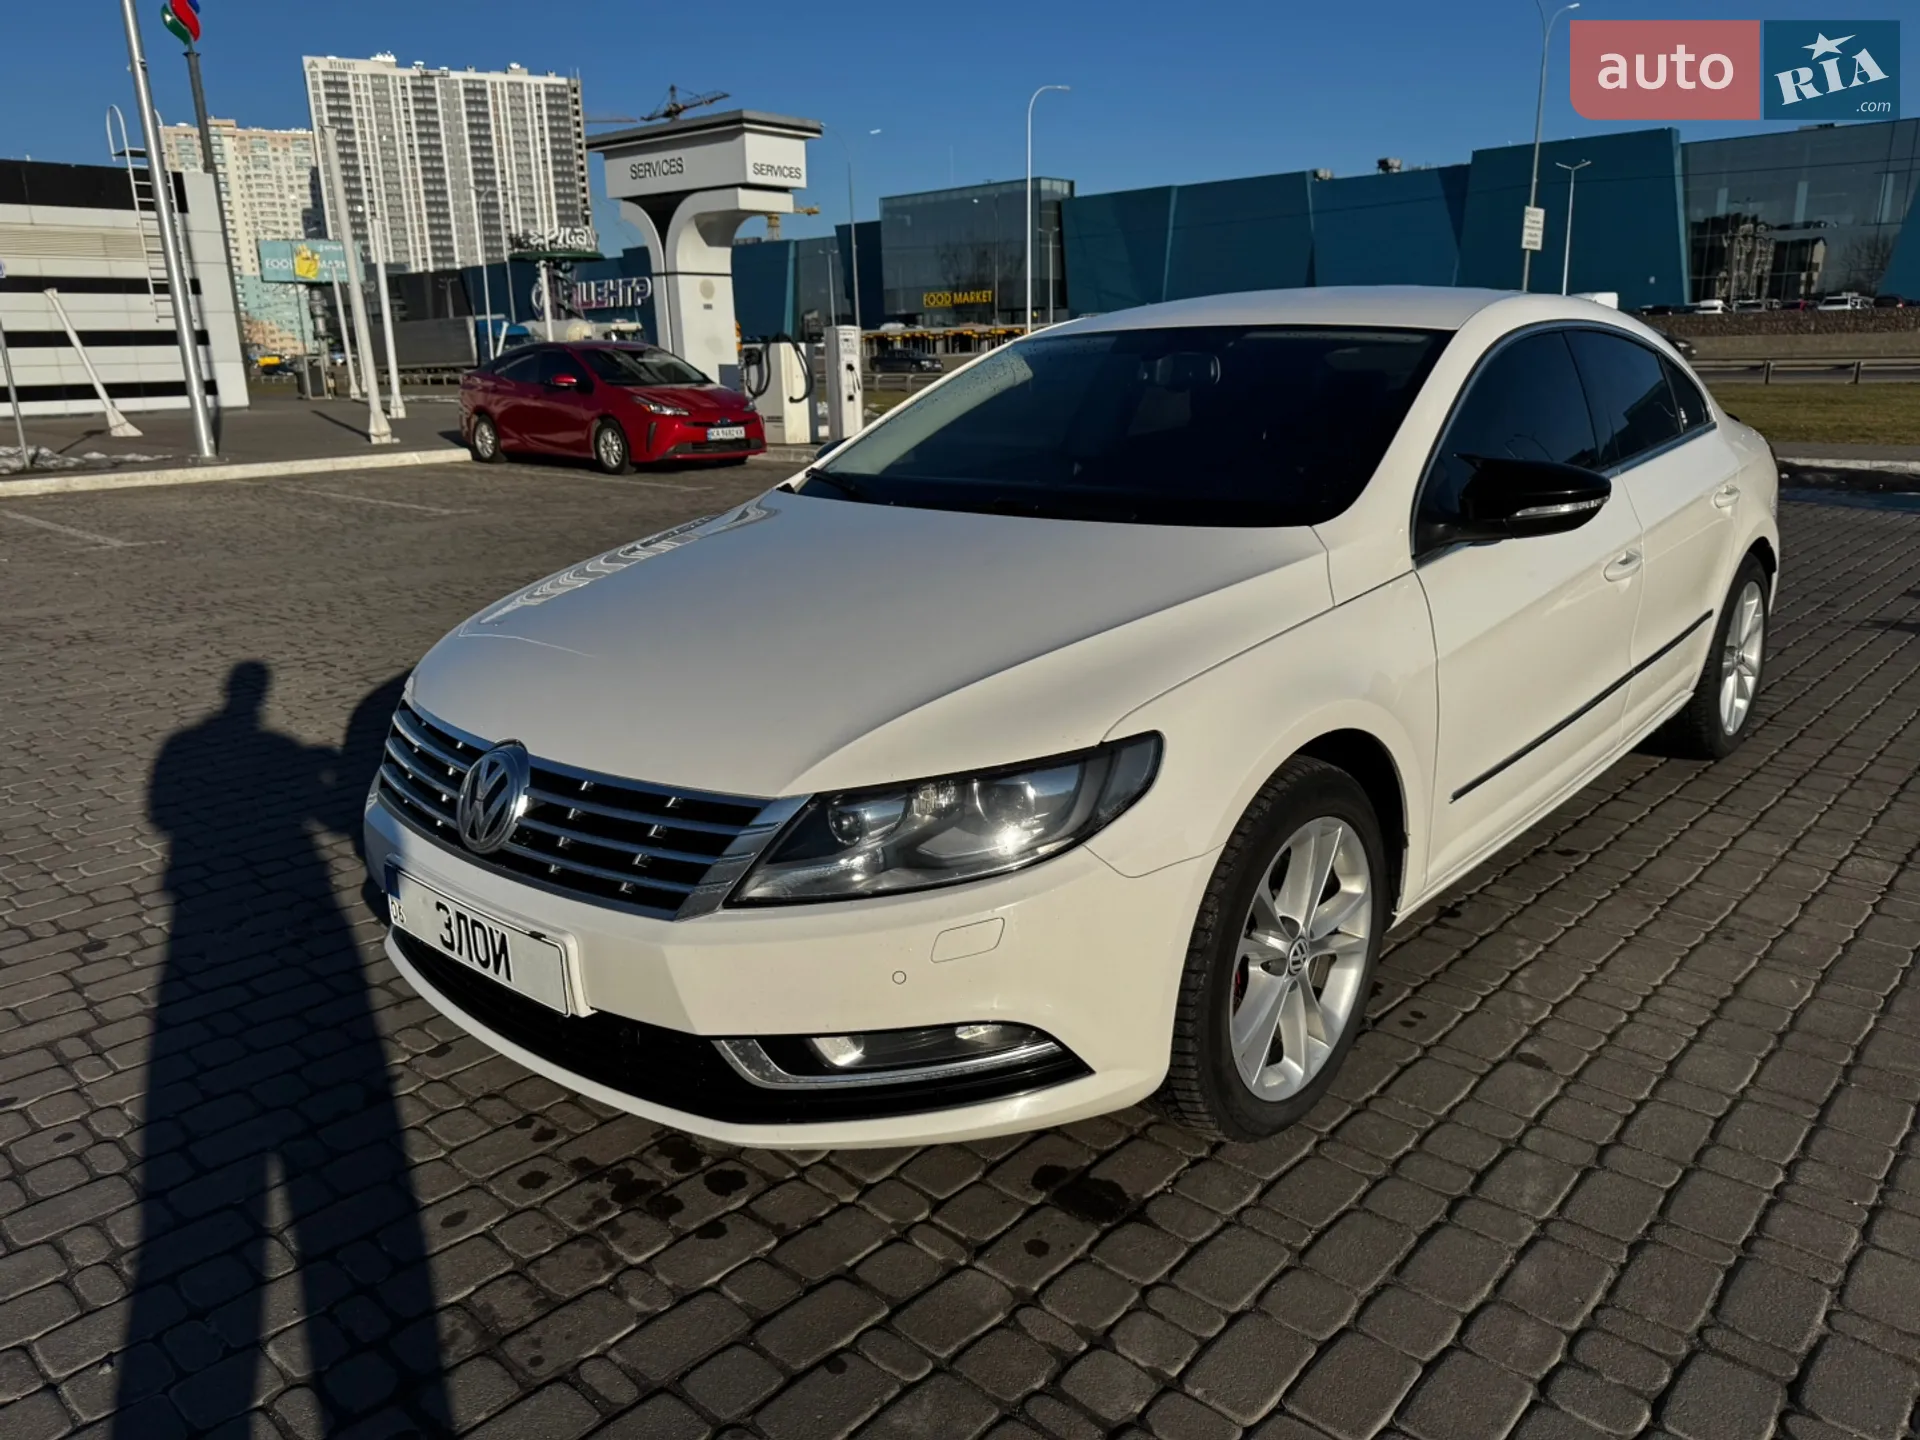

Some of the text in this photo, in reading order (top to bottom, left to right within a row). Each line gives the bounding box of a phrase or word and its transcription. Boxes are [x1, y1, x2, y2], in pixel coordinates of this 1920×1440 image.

[630, 157, 684, 180] SERVICES
[752, 162, 802, 180] SERVICES
[923, 289, 993, 308] FOOD MARKET
